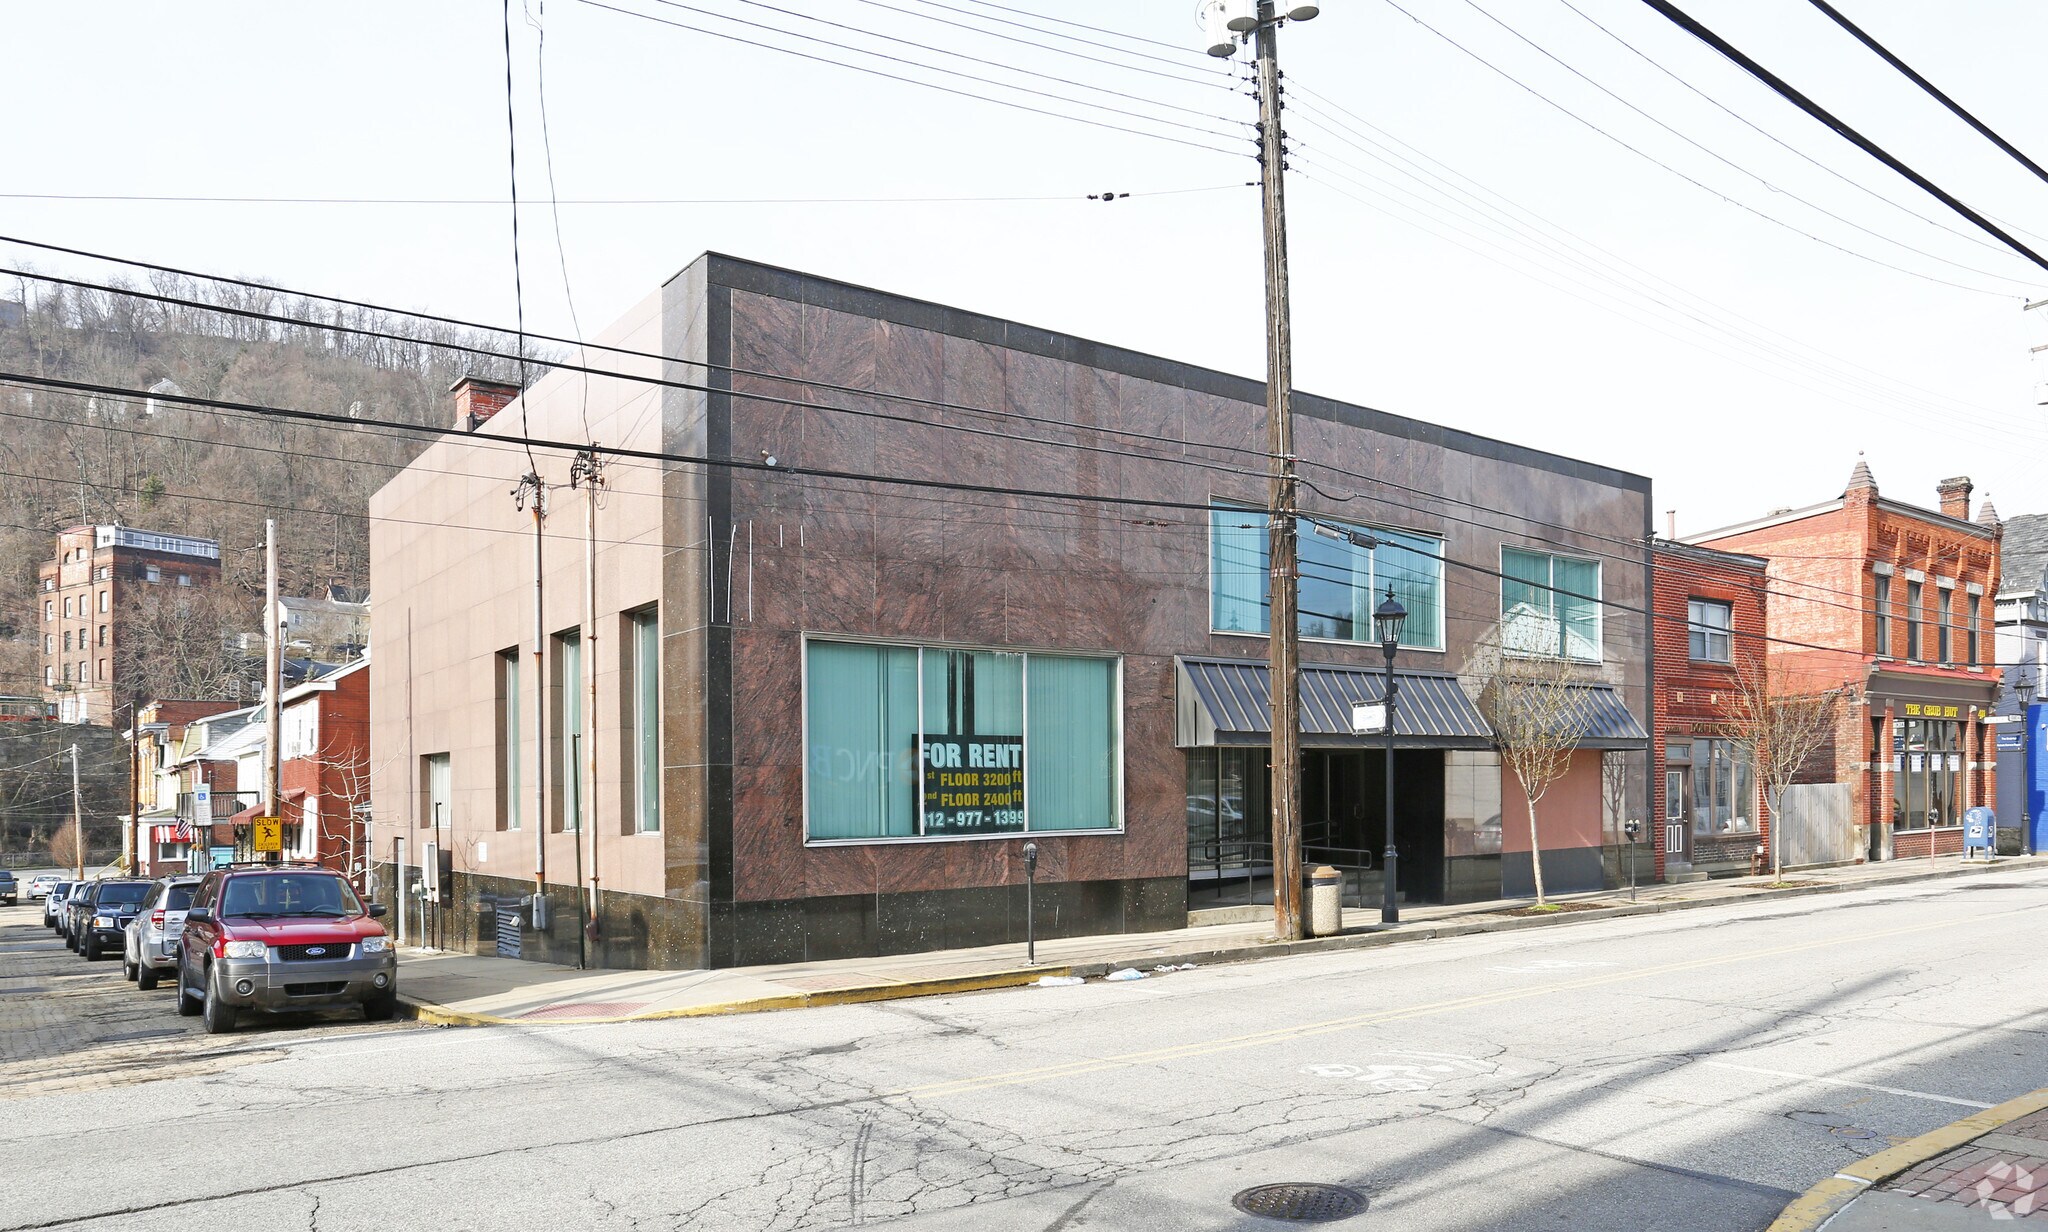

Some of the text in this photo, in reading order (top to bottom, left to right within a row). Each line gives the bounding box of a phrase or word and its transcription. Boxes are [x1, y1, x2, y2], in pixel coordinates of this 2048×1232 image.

[1906, 704, 1958, 718] THE GRUB HUT
[968, 743, 1022, 768] RENT
[940, 773, 979, 787] FLOOR
[941, 793, 980, 807] FLOOR
